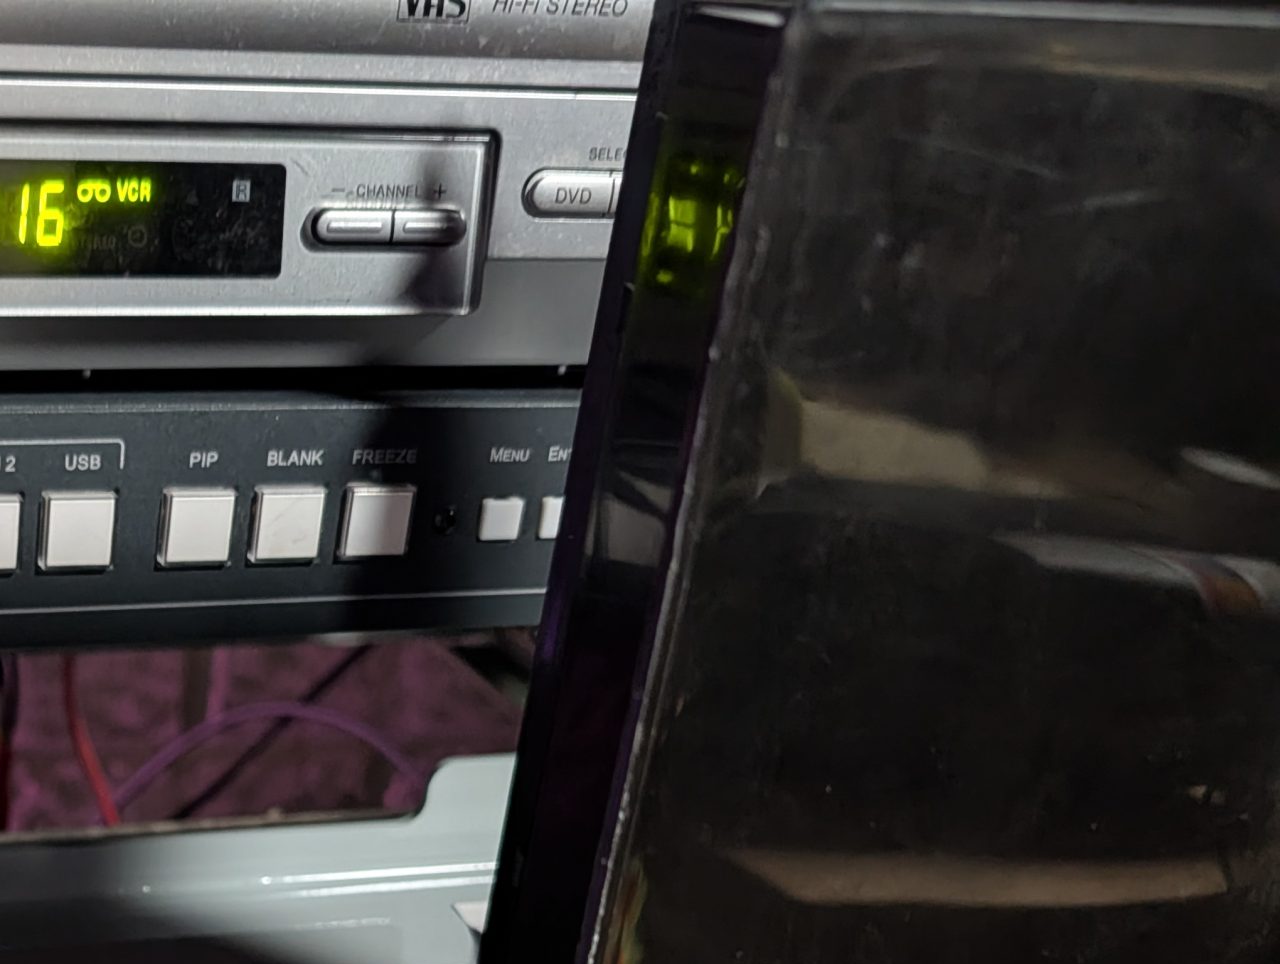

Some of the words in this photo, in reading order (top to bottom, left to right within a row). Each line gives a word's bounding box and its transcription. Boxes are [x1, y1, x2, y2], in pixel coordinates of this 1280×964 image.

[404, 0, 467, 18] VHS
[546, 0, 629, 17] STEREO
[589, 147, 626, 161] SELE
[116, 178, 151, 203] VCR
[356, 183, 420, 199] CHANNEL
[554, 187, 592, 205] DVD
[3, 455, 16, 473] 2
[64, 454, 102, 472] USB
[189, 451, 219, 469] PIP
[266, 449, 324, 468] BLANK
[352, 449, 418, 466] FREEZE
[489, 447, 531, 463] MENU
